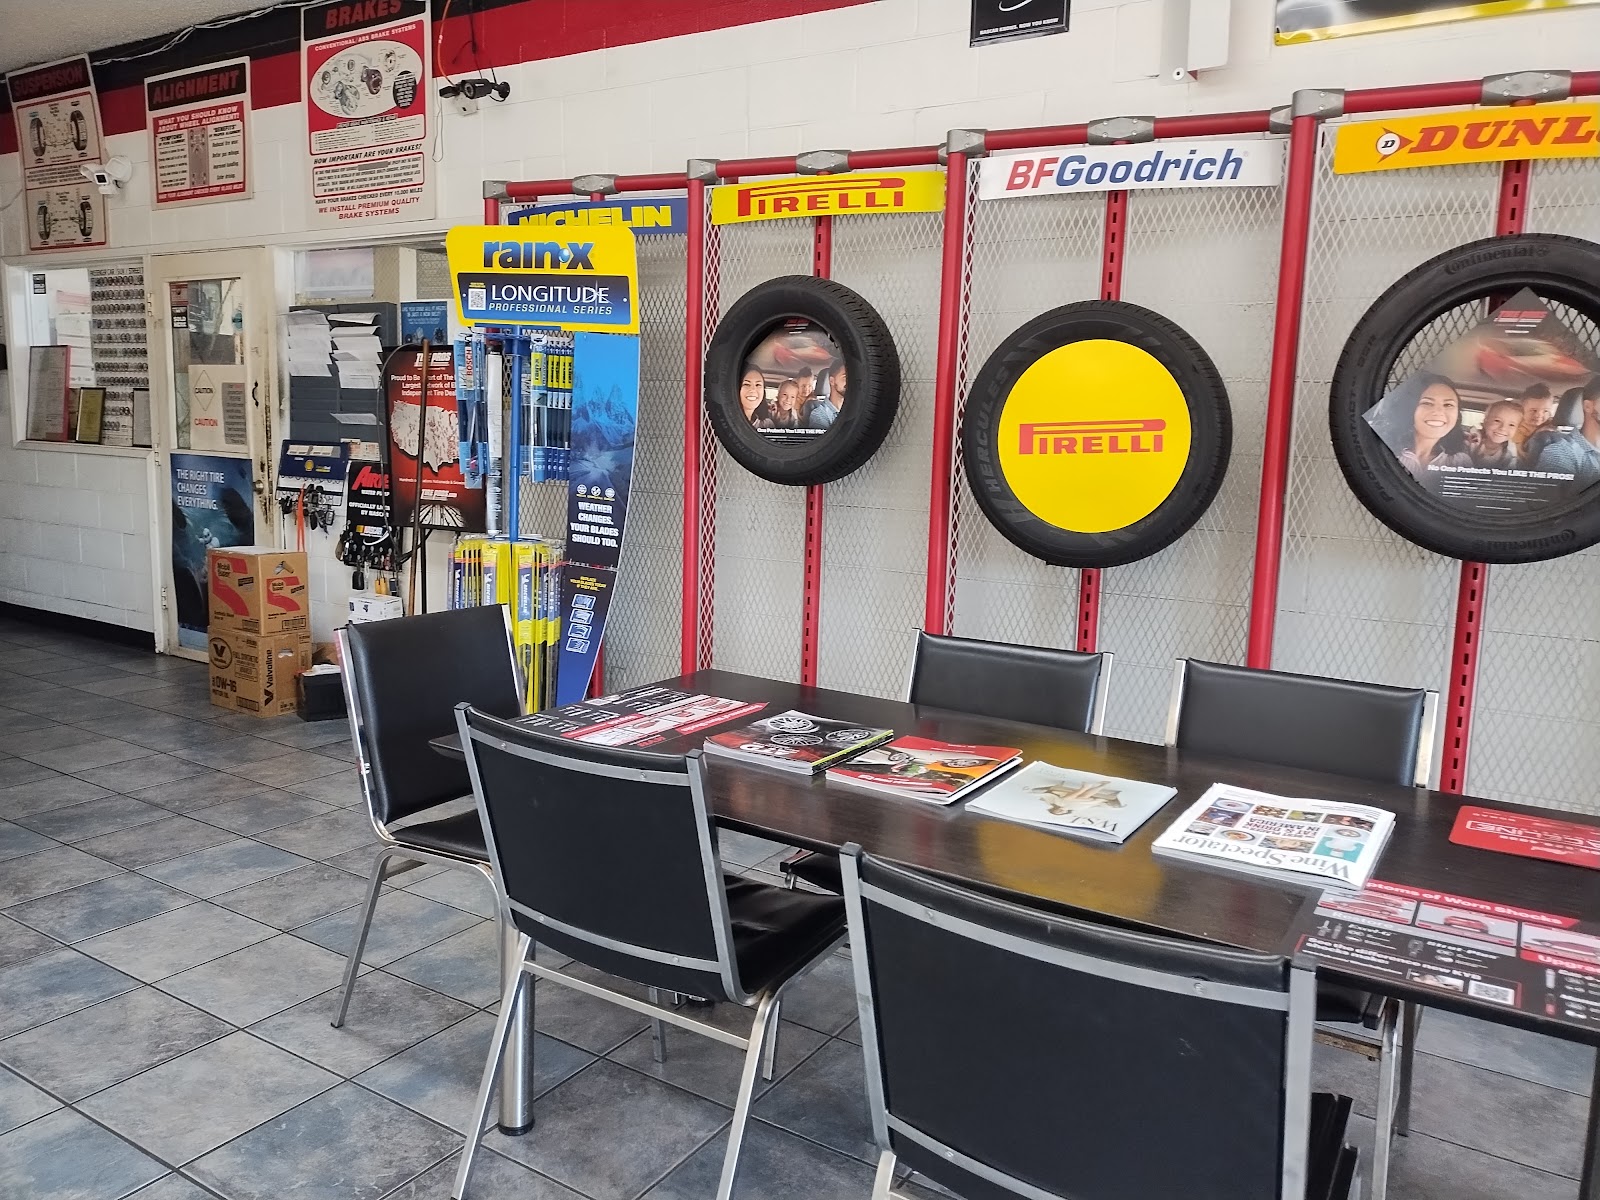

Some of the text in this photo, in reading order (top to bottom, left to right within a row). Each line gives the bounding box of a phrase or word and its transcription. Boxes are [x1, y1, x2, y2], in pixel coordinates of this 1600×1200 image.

[326, 0, 402, 29] BRAKES
[371, 30, 390, 40] BRAKE
[391, 24, 416, 34] SYSTEMS
[14, 66, 84, 97] SUSPENSION
[153, 70, 239, 104] ALIGNMENT
[158, 106, 238, 126] WHAT YOU SHOULD KNOW
[158, 123, 178, 132] ABOUT
[180, 120, 200, 129] WHEEL
[1408, 115, 1600, 154] DUNL
[329, 152, 362, 163] IMPORTANT
[363, 150, 376, 158] ARE
[378, 148, 393, 156] YOUR
[395, 144, 422, 154] BRAKES?
[1006, 147, 1244, 192] BFGoodrich
[318, 196, 420, 214] WE INSTALL PREMIUM QUALITY
[737, 177, 906, 217] PIRELLI
[338, 207, 400, 220] BRAKE SYSTEMS
[1445, 246, 1537, 276] Continental
[491, 284, 610, 305] LONGITUDE
[488, 303, 613, 315] PROFESSIONAL SERIES
[194, 418, 218, 427] CAUTION
[977, 368, 1008, 493] HERCULES
[1018, 419, 1167, 455] PIRELLI
[176, 468, 225, 483] THE RIGHT TIRE
[1440, 465, 1457, 473] One
[1458, 466, 1491, 475] Protects
[1491, 468, 1508, 476] You
[1508, 469, 1528, 477] LIKE
[1529, 470, 1547, 479] THE
[1547, 472, 1575, 481] PROS!
[177, 482, 207, 495] CHANGES
[177, 496, 219, 510] EVERYTHING.
[578, 501, 612, 514] WEATHER
[368, 510, 389, 518] NASCR
[578, 512, 614, 525] CHANGES.
[570, 522, 619, 537] YOUR BLADES
[572, 533, 618, 548] SHOULD TOO.
[217, 562, 230, 571] Mobil
[266, 649, 274, 688] Valvoline
[1245, 821, 1281, 832] DRINK
[1249, 818, 1302, 830] AMERICA
[1171, 835, 1350, 878] Wine Spectator
[1422, 892, 1442, 900] of
[1444, 896, 1492, 911] Worn
[1494, 906, 1563, 925] Shocks
[1332, 911, 1394, 929] Restore
[1307, 937, 1482, 981] See the difference new KYB
